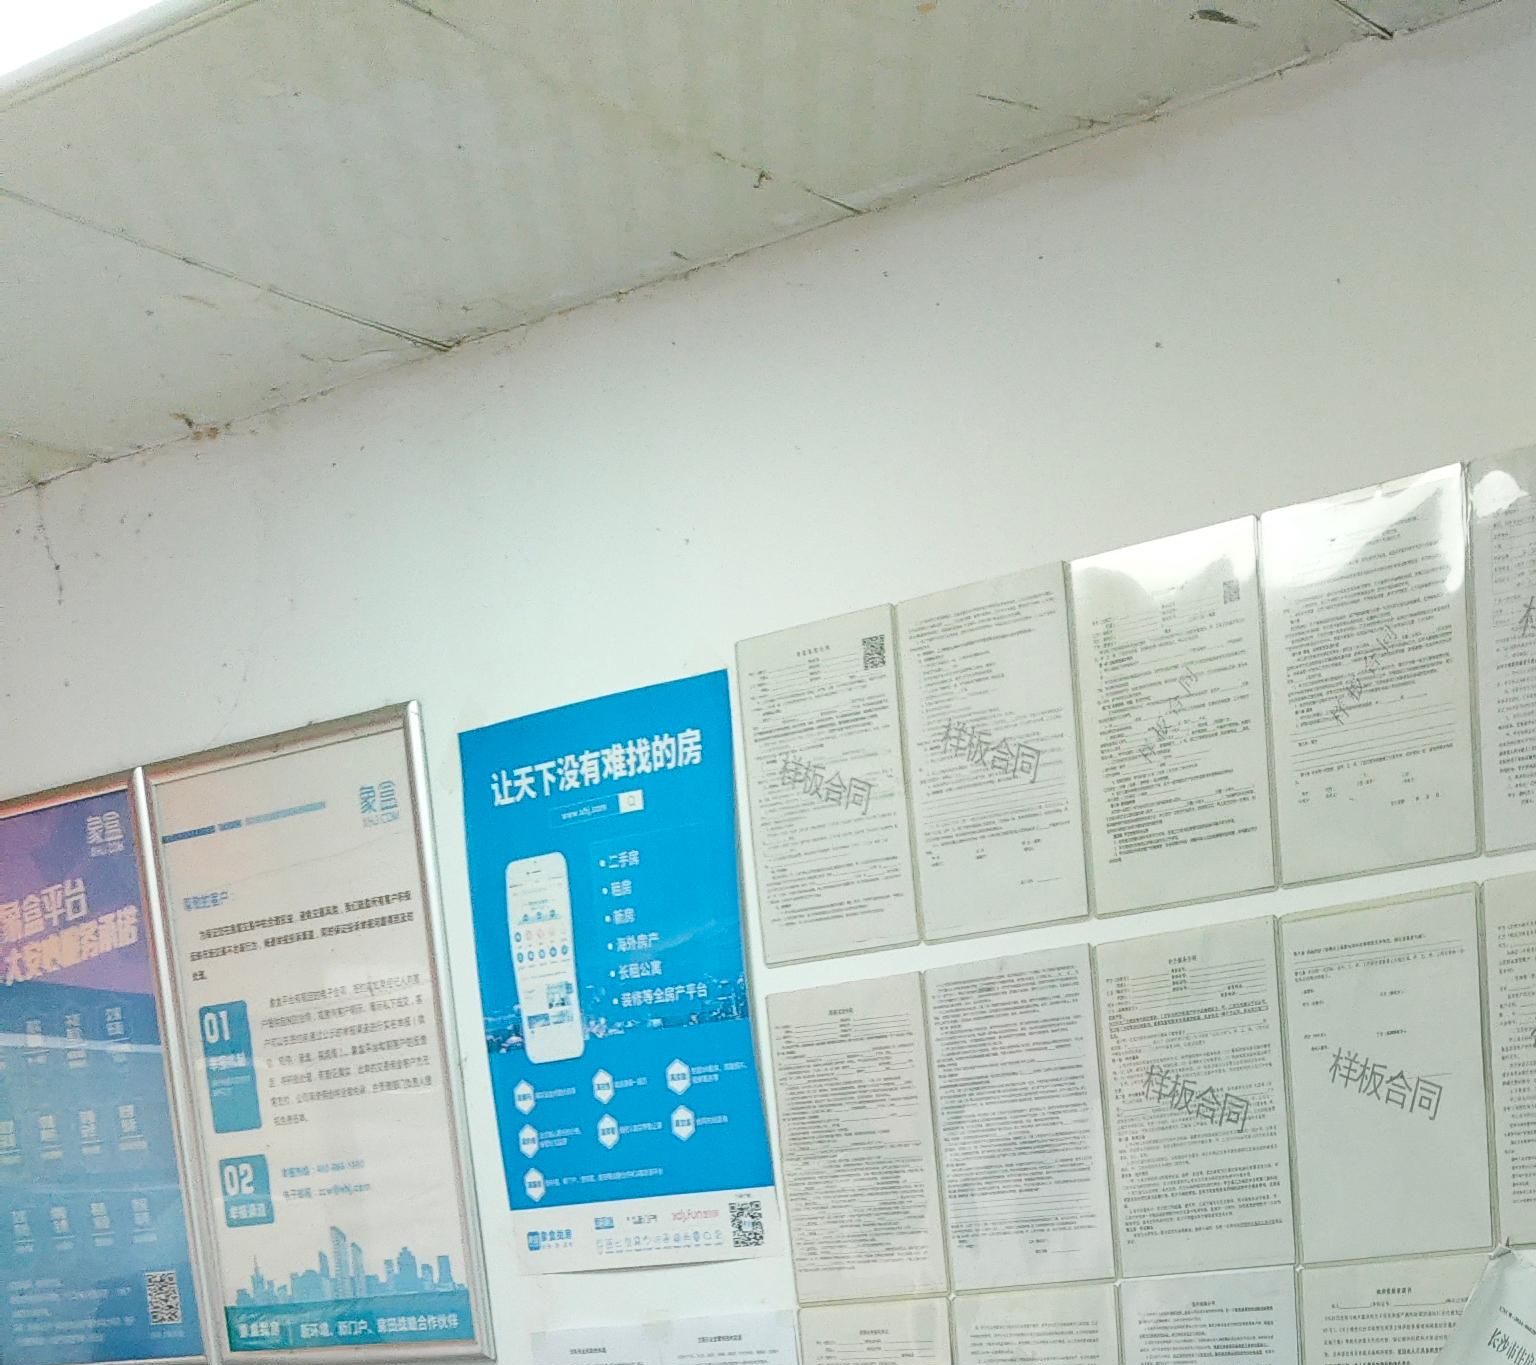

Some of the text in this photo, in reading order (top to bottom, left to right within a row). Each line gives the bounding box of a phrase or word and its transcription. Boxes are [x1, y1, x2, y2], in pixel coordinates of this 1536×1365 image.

[490, 728, 702, 807] 让天下没有难找的房
[780, 751, 873, 815] 样板合同
[940, 717, 1041, 784] 样板合同
[608, 849, 640, 869] 二手房
[203, 1010, 231, 1043] 01
[1142, 1064, 1252, 1133] 样板合同
[1328, 1046, 1445, 1120] 样板合同
[224, 1163, 255, 1195] 02
